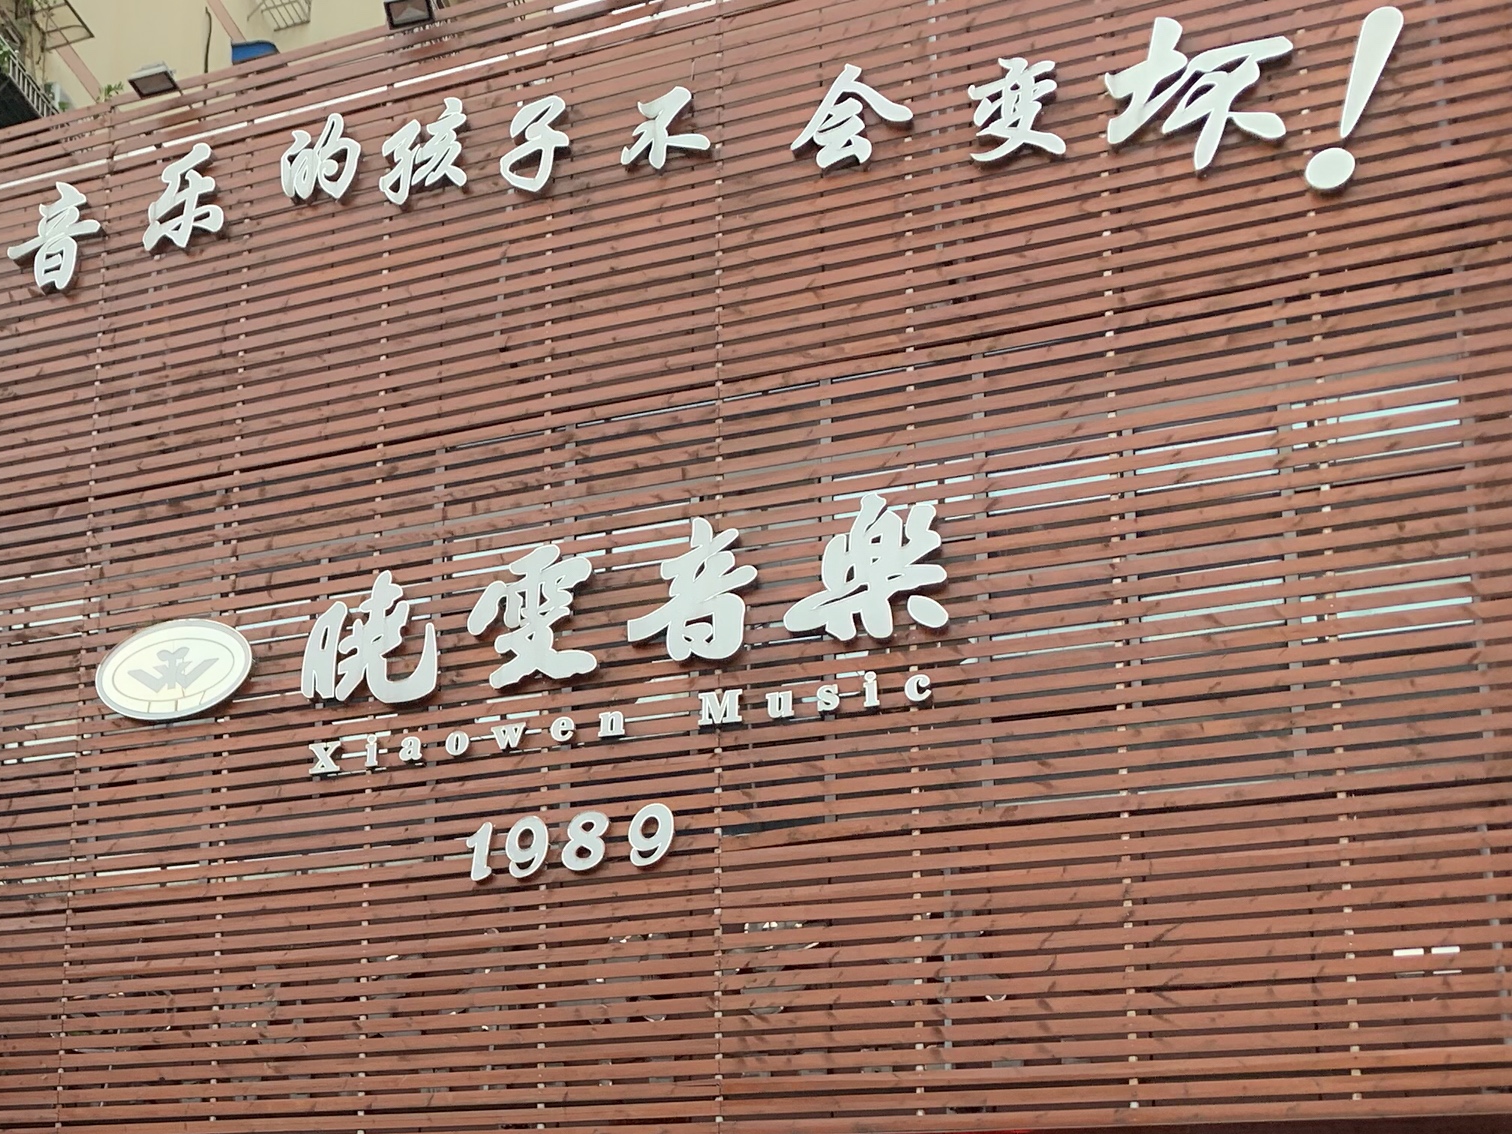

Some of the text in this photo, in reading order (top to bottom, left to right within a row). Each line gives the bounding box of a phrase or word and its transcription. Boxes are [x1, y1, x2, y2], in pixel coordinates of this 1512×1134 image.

[308, 670, 934, 776] Xiaowen Music
[466, 802, 676, 882] 1989
